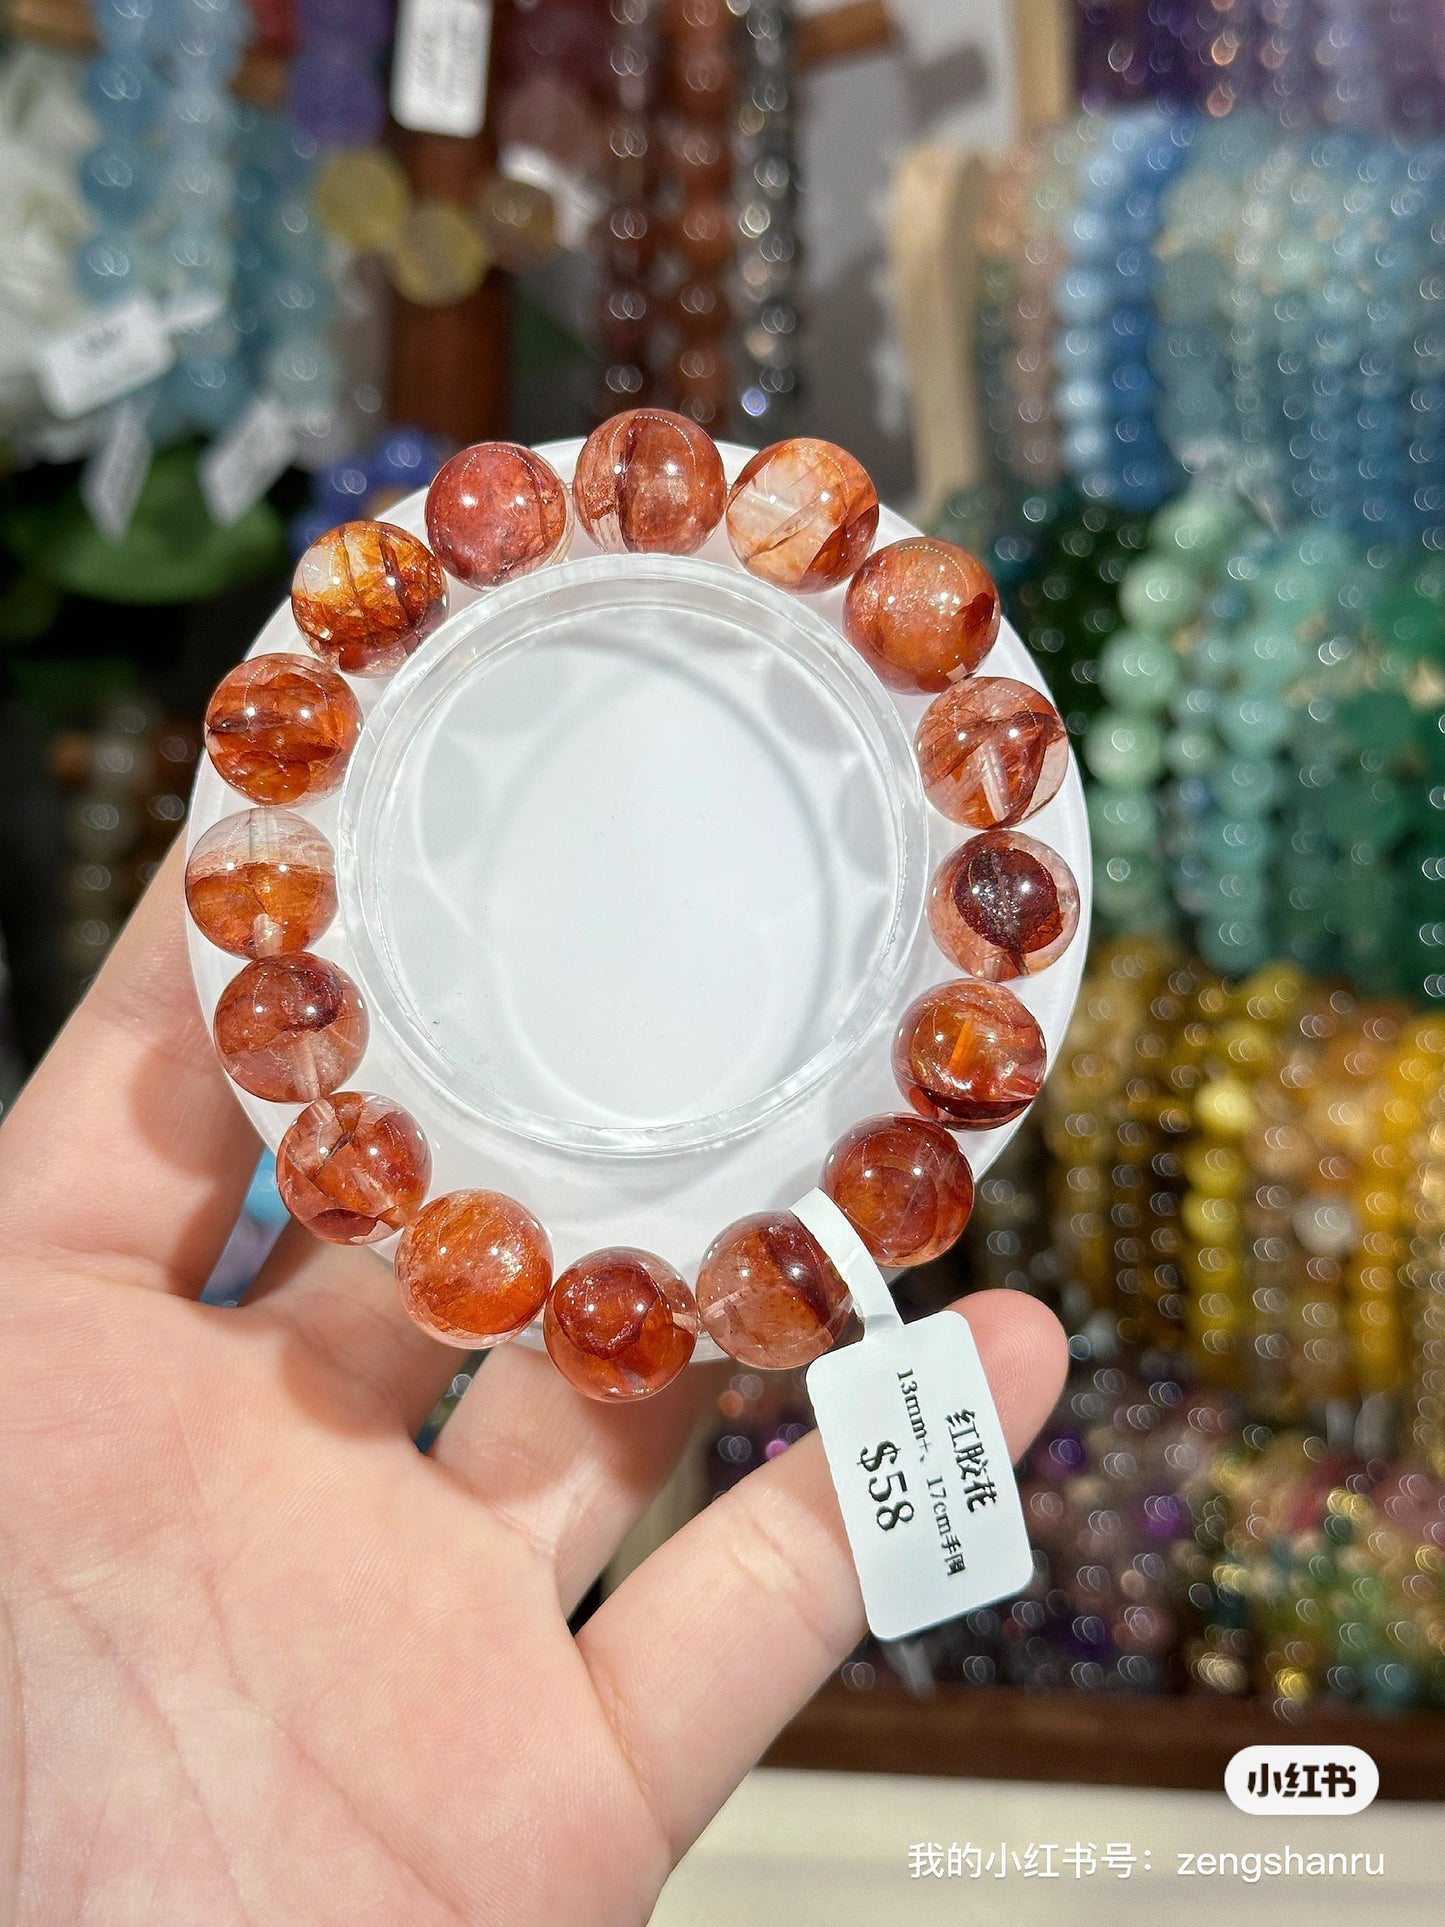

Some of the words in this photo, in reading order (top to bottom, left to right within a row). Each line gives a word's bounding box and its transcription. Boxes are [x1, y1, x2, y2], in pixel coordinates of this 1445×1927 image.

[857, 1440, 915, 1532] $58
[945, 1408, 998, 1514] 红胶花
